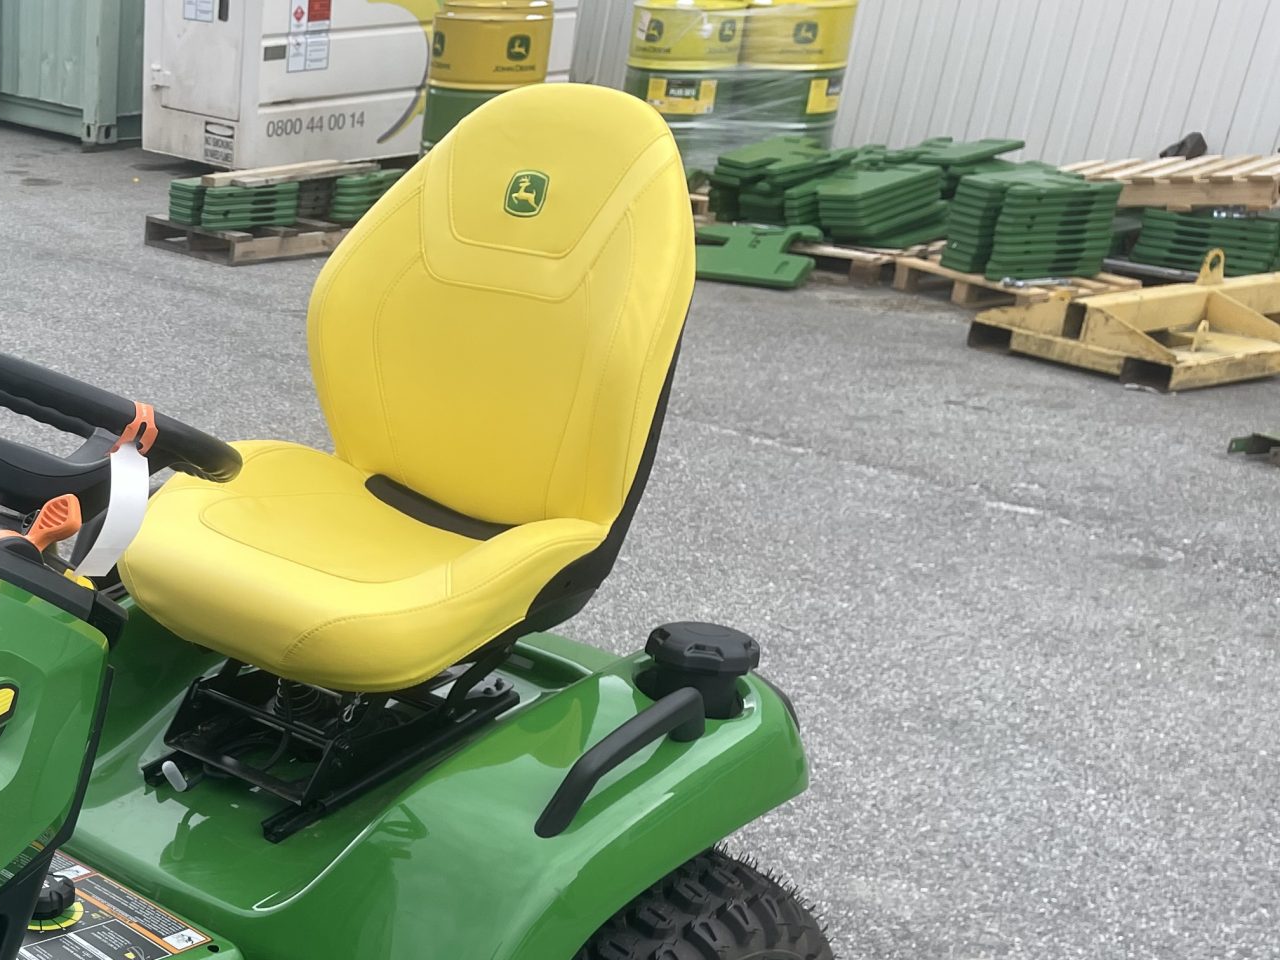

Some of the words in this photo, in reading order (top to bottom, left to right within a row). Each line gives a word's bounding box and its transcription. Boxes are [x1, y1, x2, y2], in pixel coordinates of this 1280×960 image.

[266, 117, 303, 138] 0800
[306, 115, 324, 132] 44
[328, 113, 346, 131] 00
[349, 111, 365, 128] 14
